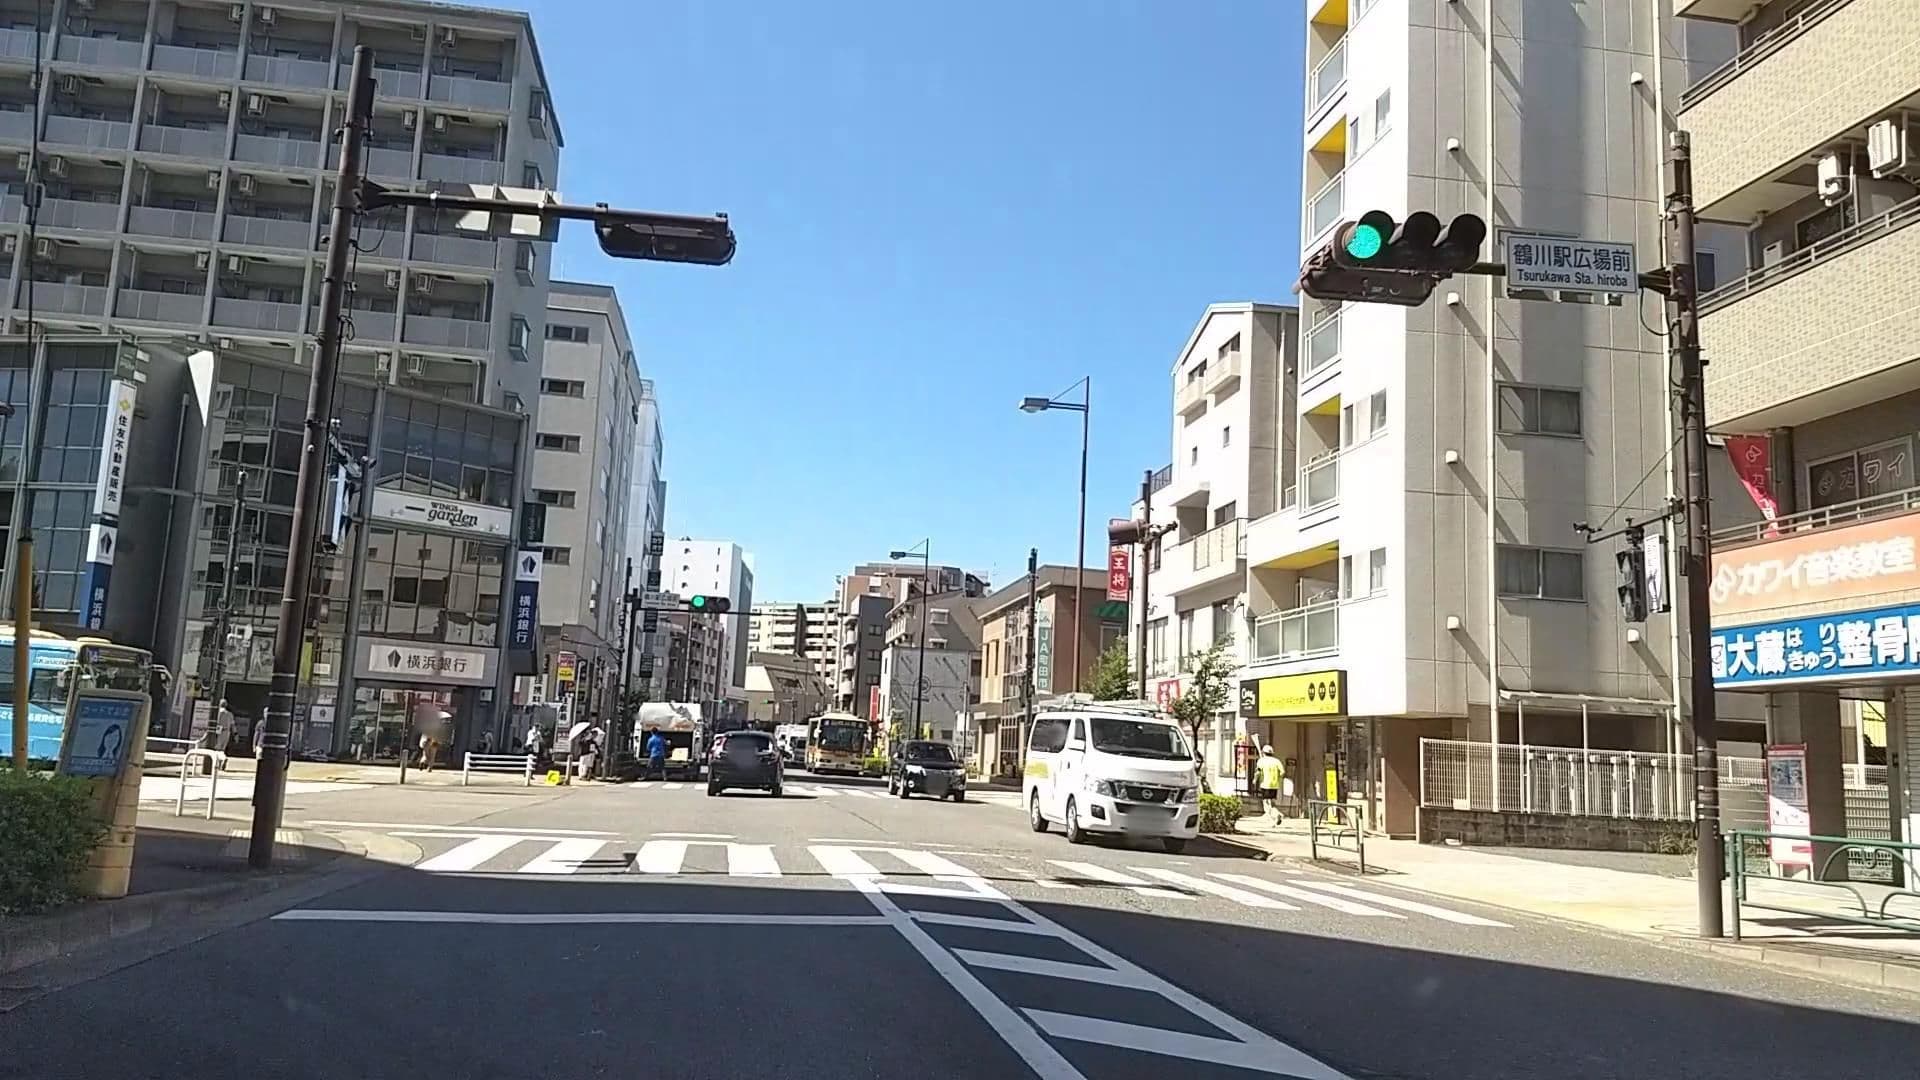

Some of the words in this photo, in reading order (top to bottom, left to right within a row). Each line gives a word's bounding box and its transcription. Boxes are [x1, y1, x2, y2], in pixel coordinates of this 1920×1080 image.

[1513, 243, 1631, 273] 鶴川駅広場前
[1517, 268, 1571, 284] Tsurukawa
[1574, 271, 1594, 285] Sta.
[1597, 274, 1628, 287] hiroba
[107, 414, 128, 503] 住友不動産販売
[1839, 450, 1905, 491] カワイ
[427, 507, 479, 527] garden
[430, 501, 458, 512] WINGS
[1112, 556, 1126, 587] 王将
[1736, 535, 1917, 597] カワイ音楽教室
[516, 595, 531, 643] 横浜銀行
[407, 653, 468, 673] 横浜銀行
[1038, 629, 1049, 689] JA町田市
[1727, 629, 1787, 676] 大蔵
